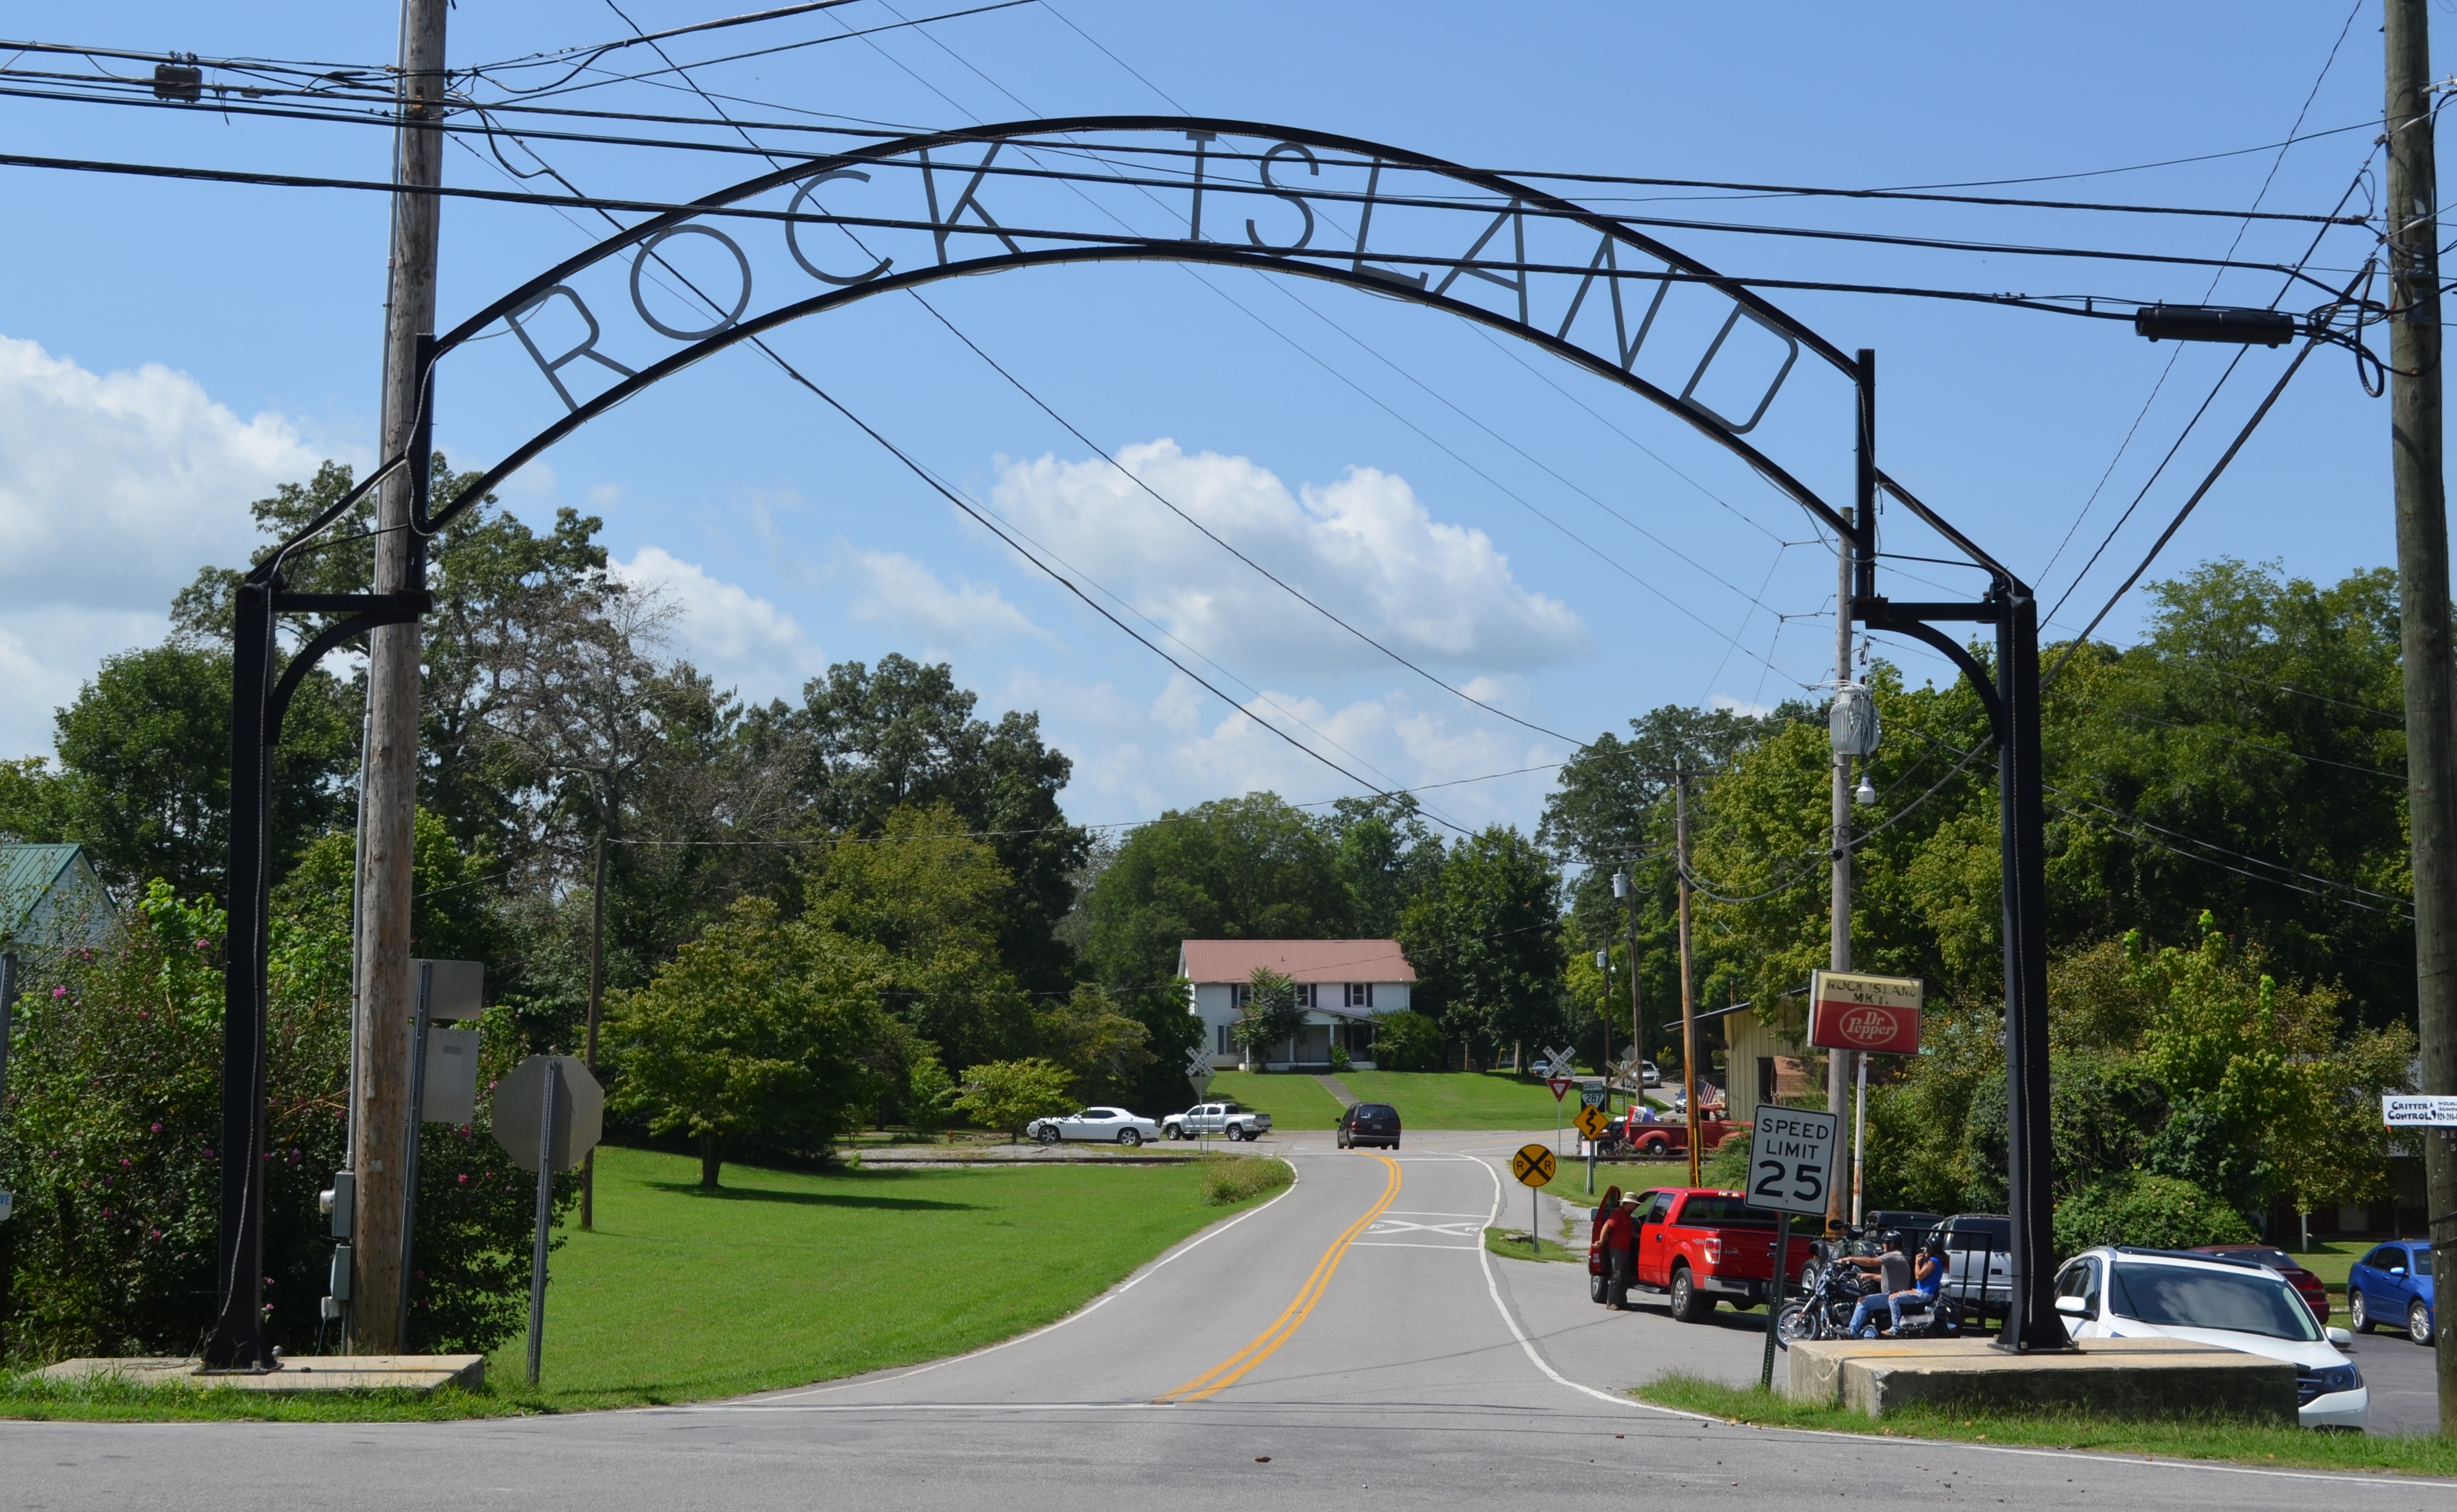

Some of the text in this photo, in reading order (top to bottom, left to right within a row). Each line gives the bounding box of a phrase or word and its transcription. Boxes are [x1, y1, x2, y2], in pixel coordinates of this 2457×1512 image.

[503, 131, 1800, 435] ROCK ISLAND
[1827, 980, 1864, 992] ROCK
[1846, 1017, 1894, 1040] Pepper
[1863, 1011, 1885, 1026] Dr
[1187, 1048, 1214, 1075] CROSSING
[1544, 1048, 1574, 1076] CROSSING
[1586, 1094, 1601, 1103] 287
[2391, 1101, 2429, 1110] CRITTER
[2388, 1110, 2431, 1120] CONTROL
[1761, 1118, 1829, 1140] SPEED
[1766, 1139, 1819, 1160] LIMIT
[1516, 1160, 1552, 1171] R R
[1754, 1159, 1823, 1202] 25
